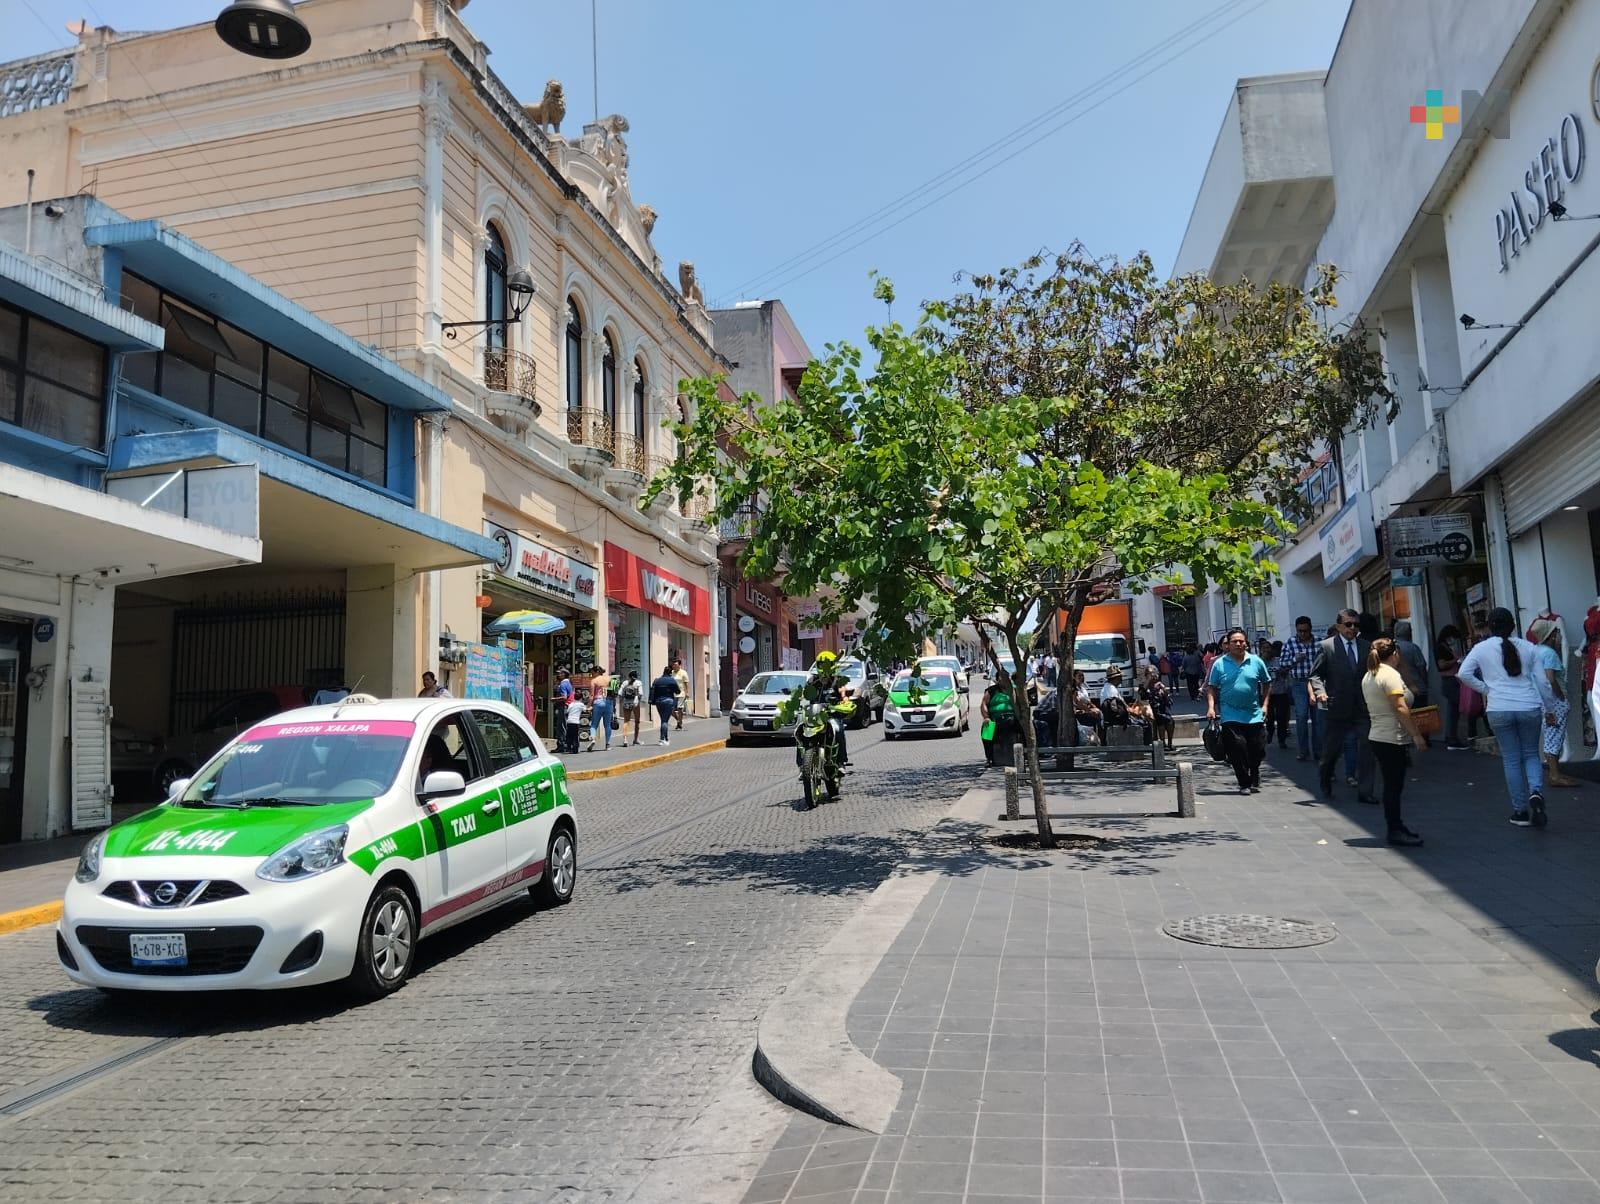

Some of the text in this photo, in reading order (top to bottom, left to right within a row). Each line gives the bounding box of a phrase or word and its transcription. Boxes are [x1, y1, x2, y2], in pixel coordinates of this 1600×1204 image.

[1496, 113, 1585, 273] PASEO
[1420, 546, 1456, 554] LLAVES
[38, 624, 51, 633] ADT
[346, 697, 366, 705] TAXI
[278, 724, 370, 735] REGION XALAPA
[450, 813, 477, 838] TAXI
[141, 829, 238, 852] XL-4144
[132, 943, 185, 957] A-678-XCG
